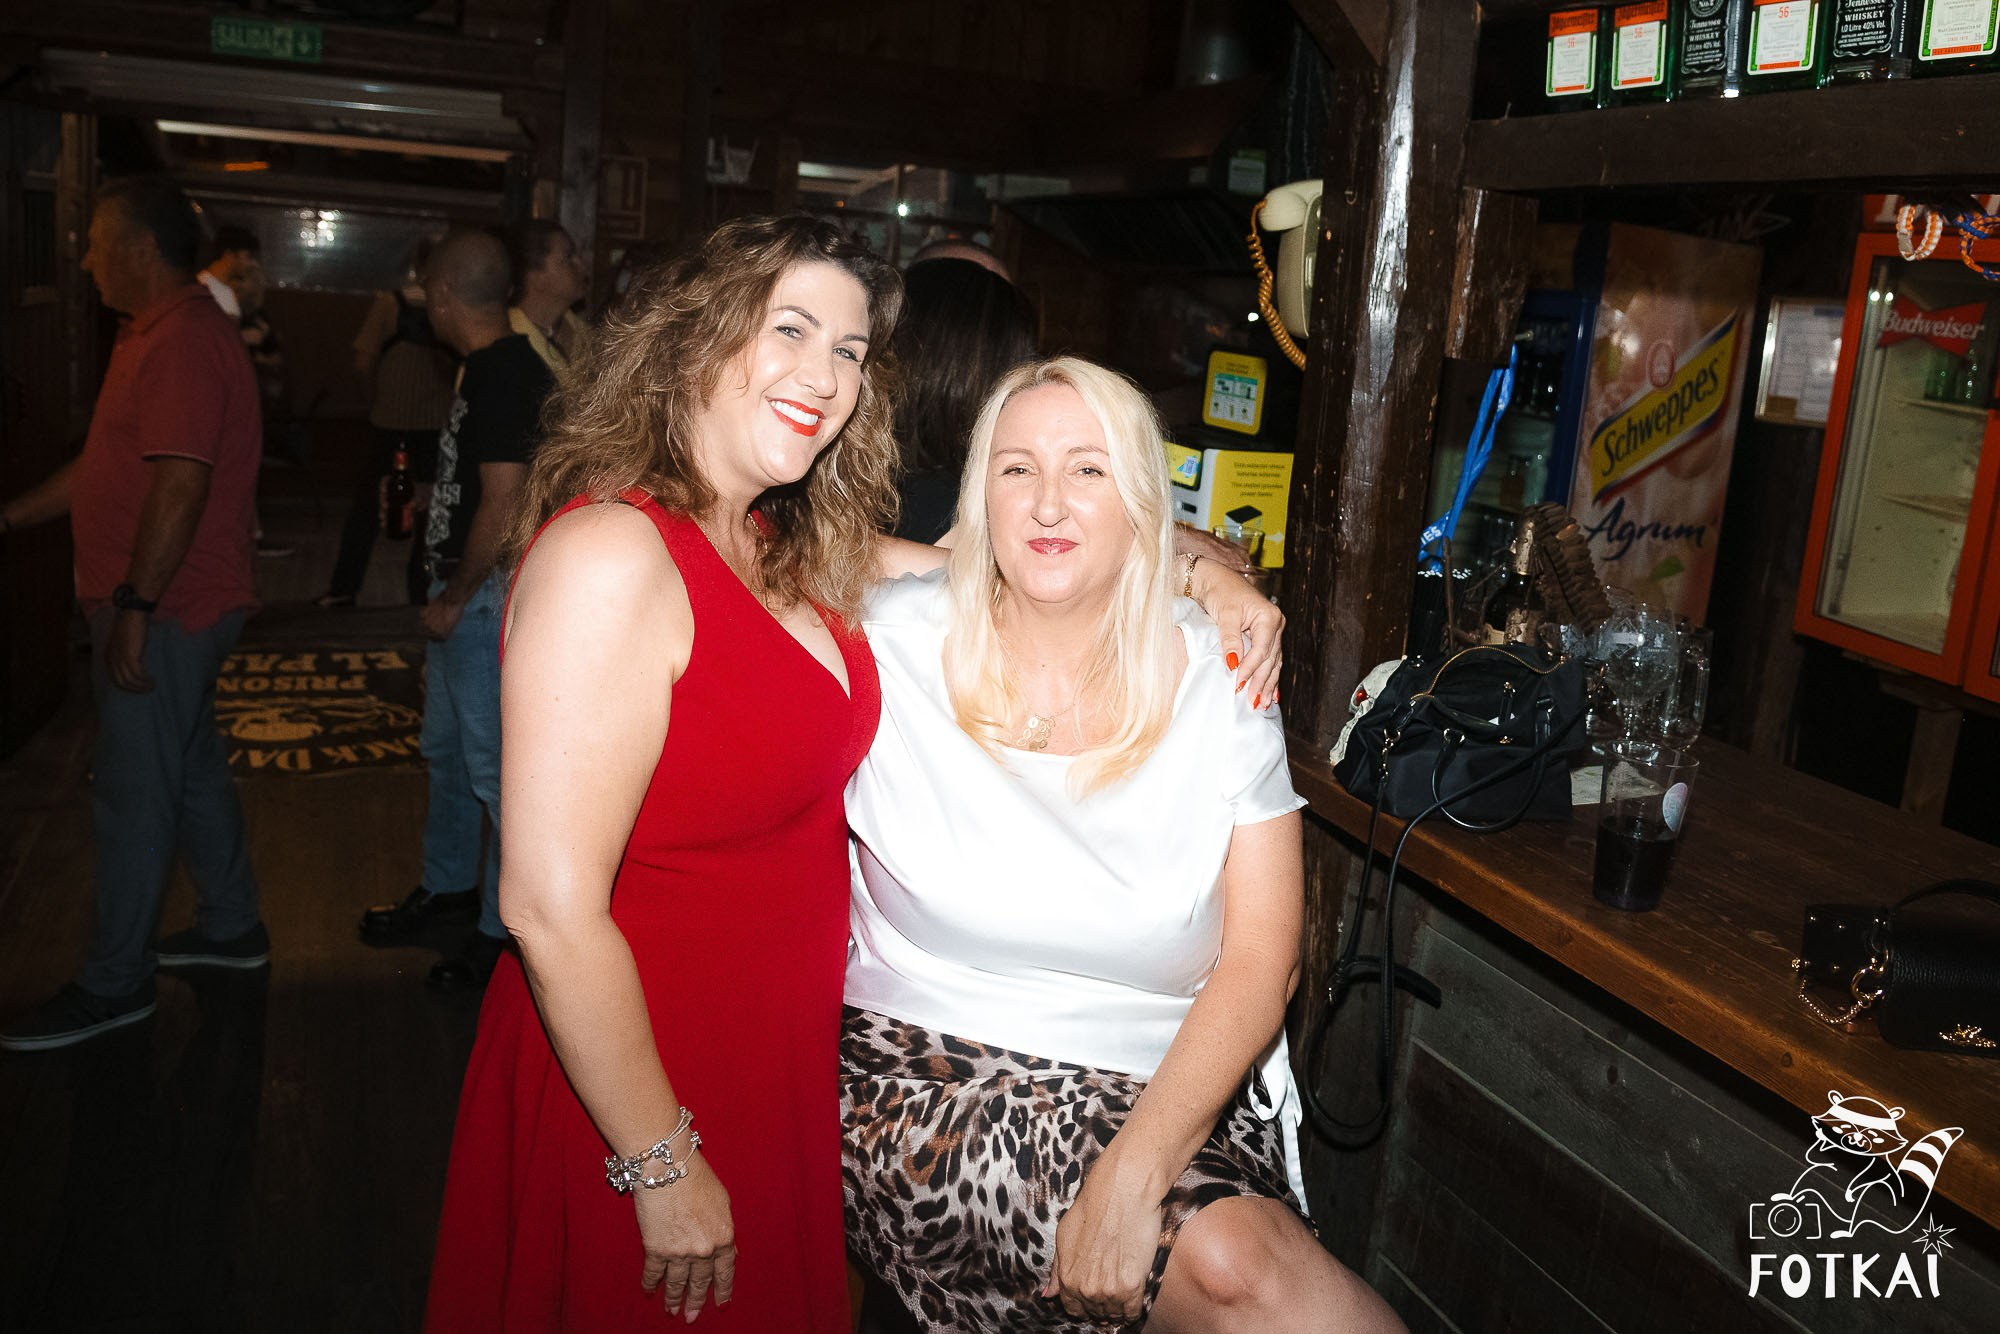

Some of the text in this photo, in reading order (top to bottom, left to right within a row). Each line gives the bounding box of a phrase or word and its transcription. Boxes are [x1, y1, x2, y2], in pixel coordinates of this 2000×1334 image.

[1778, 6, 1789, 18] 56
[1844, 10, 1885, 22] WHISKEY
[217, 24, 273, 50] SALIDA
[1882, 309, 1985, 340] Budweiser
[1601, 357, 1719, 478] Schweppes
[1583, 497, 1707, 561] Agrum
[330, 650, 410, 671] EL
[216, 673, 368, 693] PRISON
